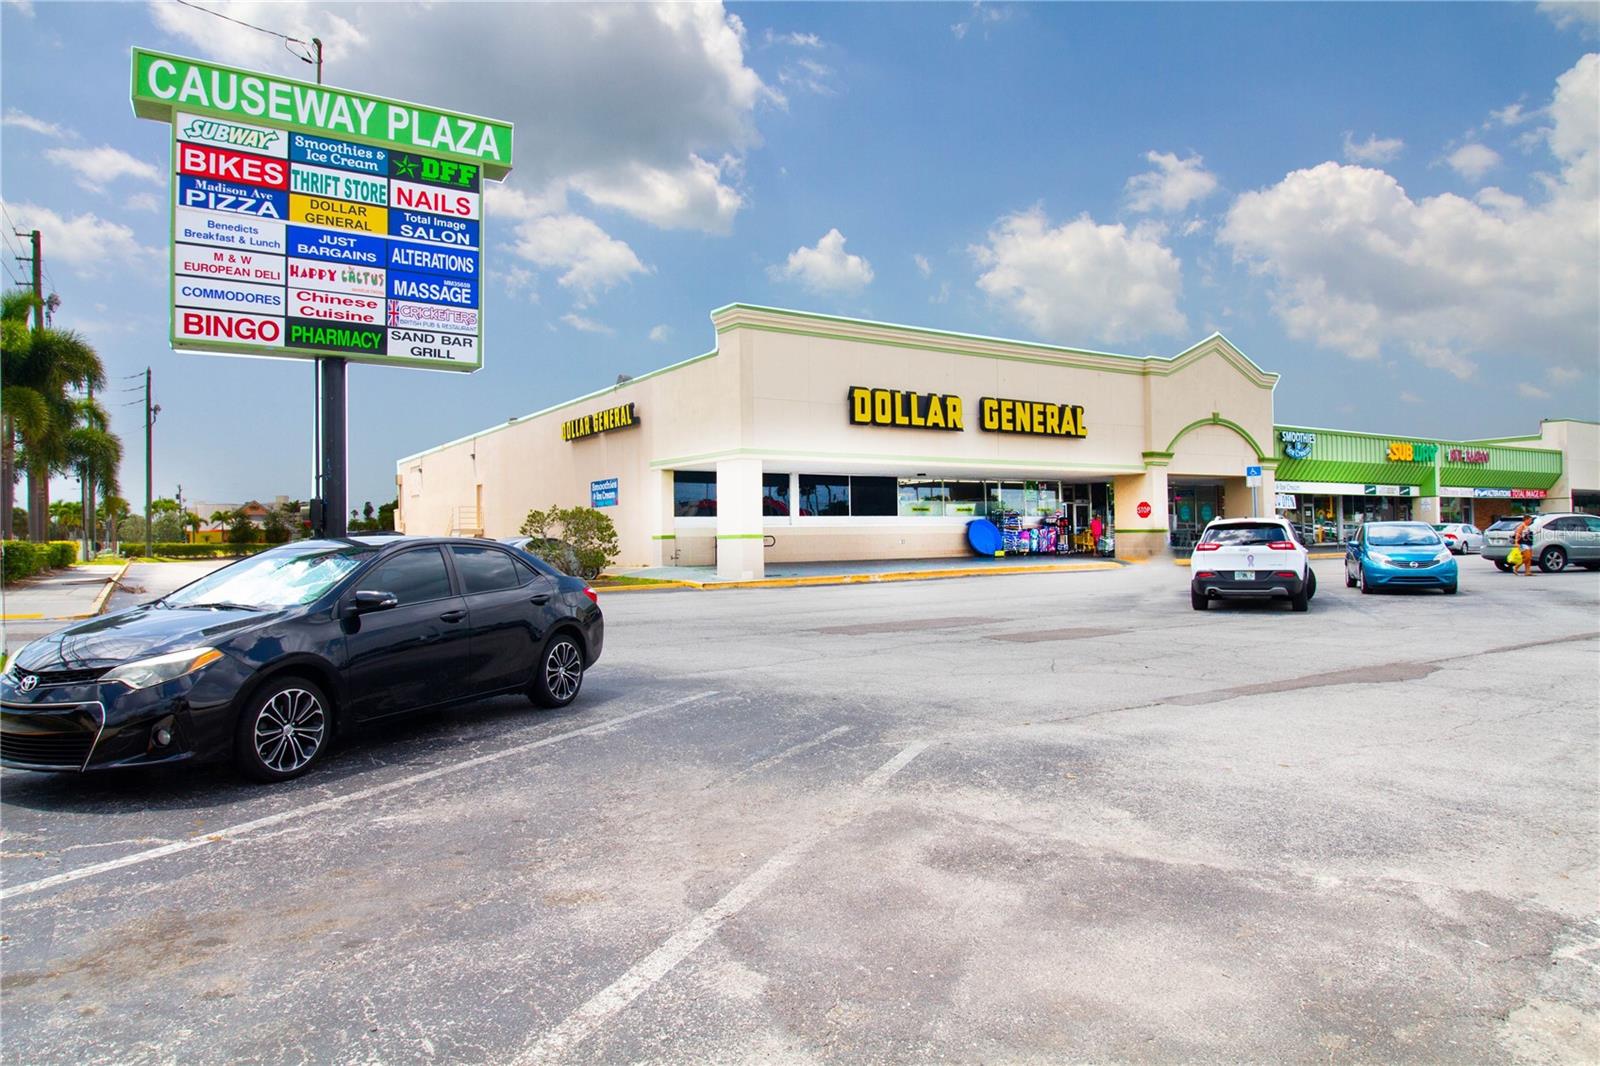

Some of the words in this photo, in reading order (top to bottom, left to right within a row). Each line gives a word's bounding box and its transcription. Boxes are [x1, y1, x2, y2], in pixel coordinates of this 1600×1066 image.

[148, 60, 377, 134] CAUSEWAY
[388, 105, 500, 160] PLAZA
[184, 120, 279, 150] SUBWAY
[295, 135, 373, 159] Smoothies
[376, 151, 385, 160] &
[184, 148, 283, 185] BIKES
[306, 149, 327, 162] Ice
[330, 153, 379, 171] Cream
[421, 157, 476, 185] DFF
[195, 179, 247, 196] Madison
[252, 189, 273, 201] Ave
[292, 169, 340, 196] THRIFT
[344, 178, 387, 204] STORE
[186, 189, 279, 219] PIZZA
[310, 199, 367, 217] DOLLAR
[397, 187, 471, 215] NAILS
[207, 220, 259, 234] Benedicts
[305, 212, 372, 231] GENERAL
[404, 212, 430, 225] Total
[434, 217, 466, 231] Image
[184, 228, 235, 243] Breakfast
[238, 236, 246, 244] &
[250, 237, 280, 249] Lunch
[318, 235, 357, 247] JUST
[400, 224, 470, 245] SALON
[214, 252, 224, 261] M
[228, 254, 236, 263] &
[240, 255, 252, 264] W
[297, 244, 377, 262] BARGAINS
[392, 248, 474, 273] ALTERATIONS
[184, 262, 250, 277] EUROPEAN
[255, 269, 280, 280] DELI
[290, 264, 337, 281] HAPPY
[341, 268, 385, 287] CACTUS
[182, 286, 281, 306] COMMODORES
[296, 291, 378, 309] Chinese
[394, 280, 471, 304] MASSAGE
[300, 306, 374, 323] Cuisine
[400, 305, 477, 325] CRICKETERS
[183, 313, 280, 342] BINGO
[291, 325, 382, 349] PHARMACY
[391, 330, 435, 343] SAND
[441, 336, 473, 348] BAR
[410, 346, 455, 360] GRILL
[561, 416, 591, 440] DOLLAR
[592, 404, 632, 433] GENERAL
[852, 386, 964, 430] DOLLAR
[982, 396, 1087, 437] GENERAL
[1281, 431, 1316, 443] SMOOTHIES
[1386, 442, 1437, 463] SUBWAY
[1137, 506, 1151, 514] STOP
